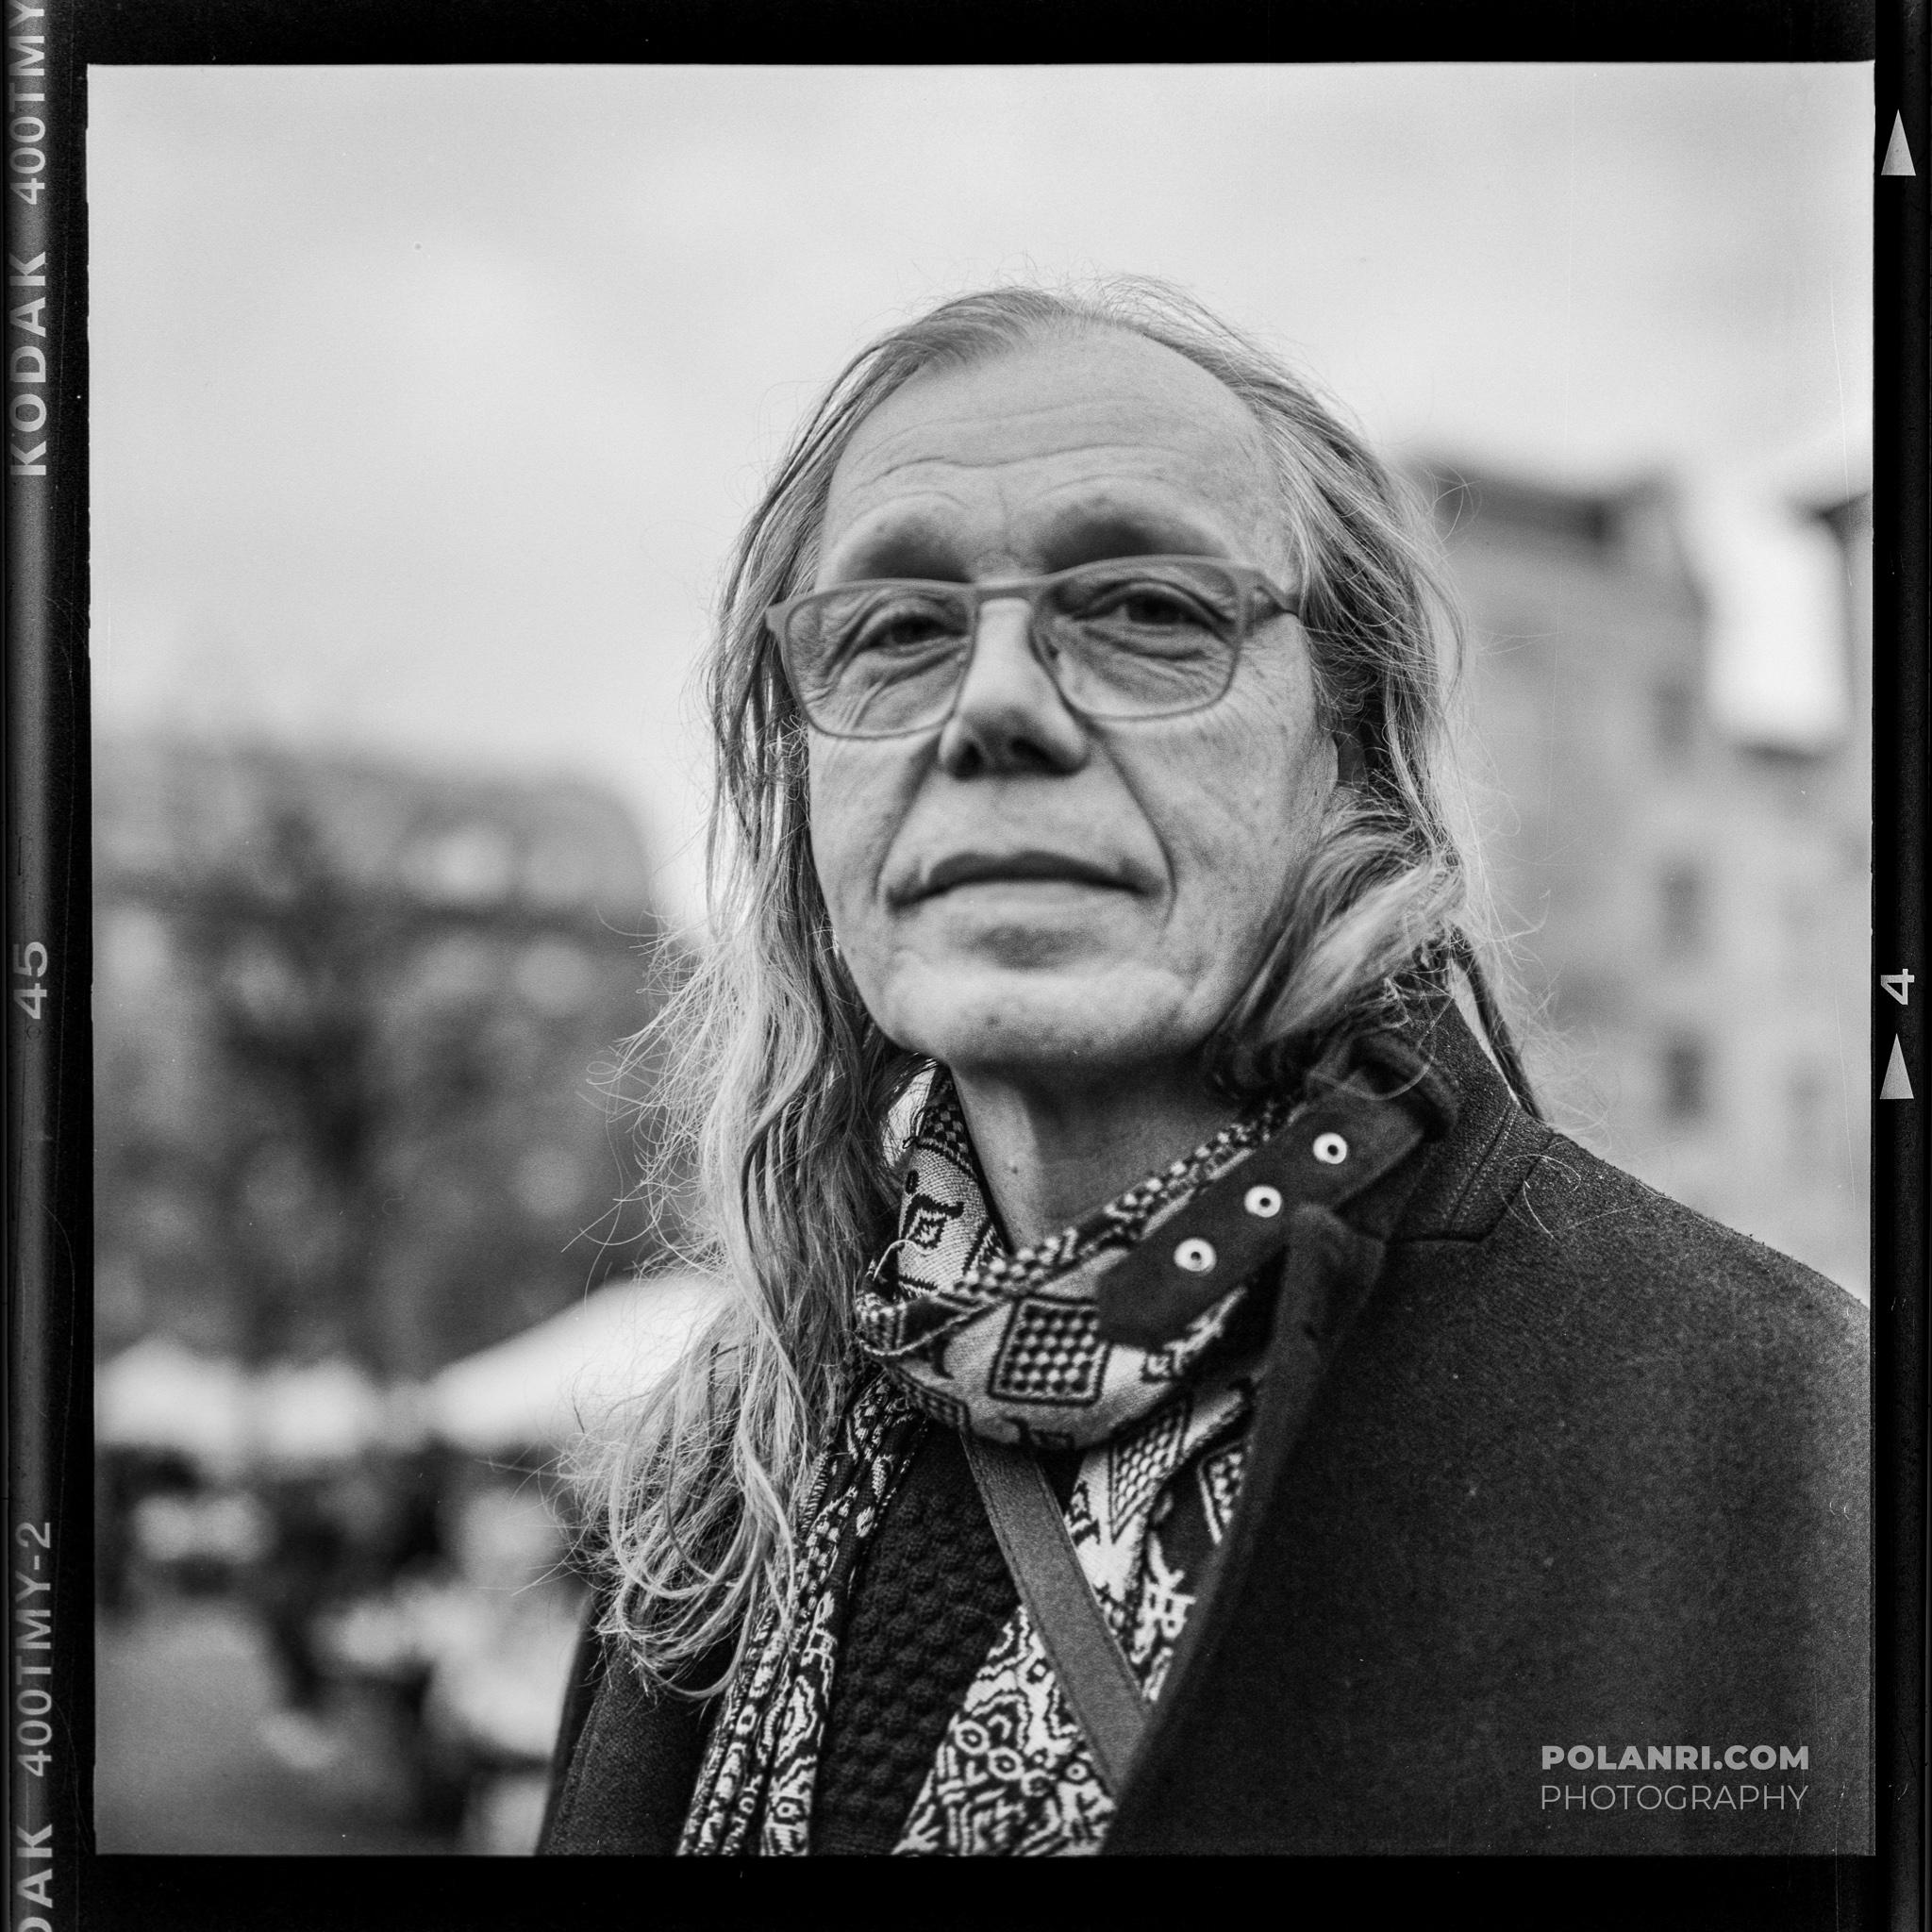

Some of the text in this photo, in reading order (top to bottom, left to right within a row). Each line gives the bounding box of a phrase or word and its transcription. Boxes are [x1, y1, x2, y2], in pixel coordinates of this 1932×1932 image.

[8, 251, 46, 475] KODAK
[13, 941, 47, 1019] 45
[1880, 968, 1915, 1005] 4
[15, 1523, 52, 1776] 400TMY-2
